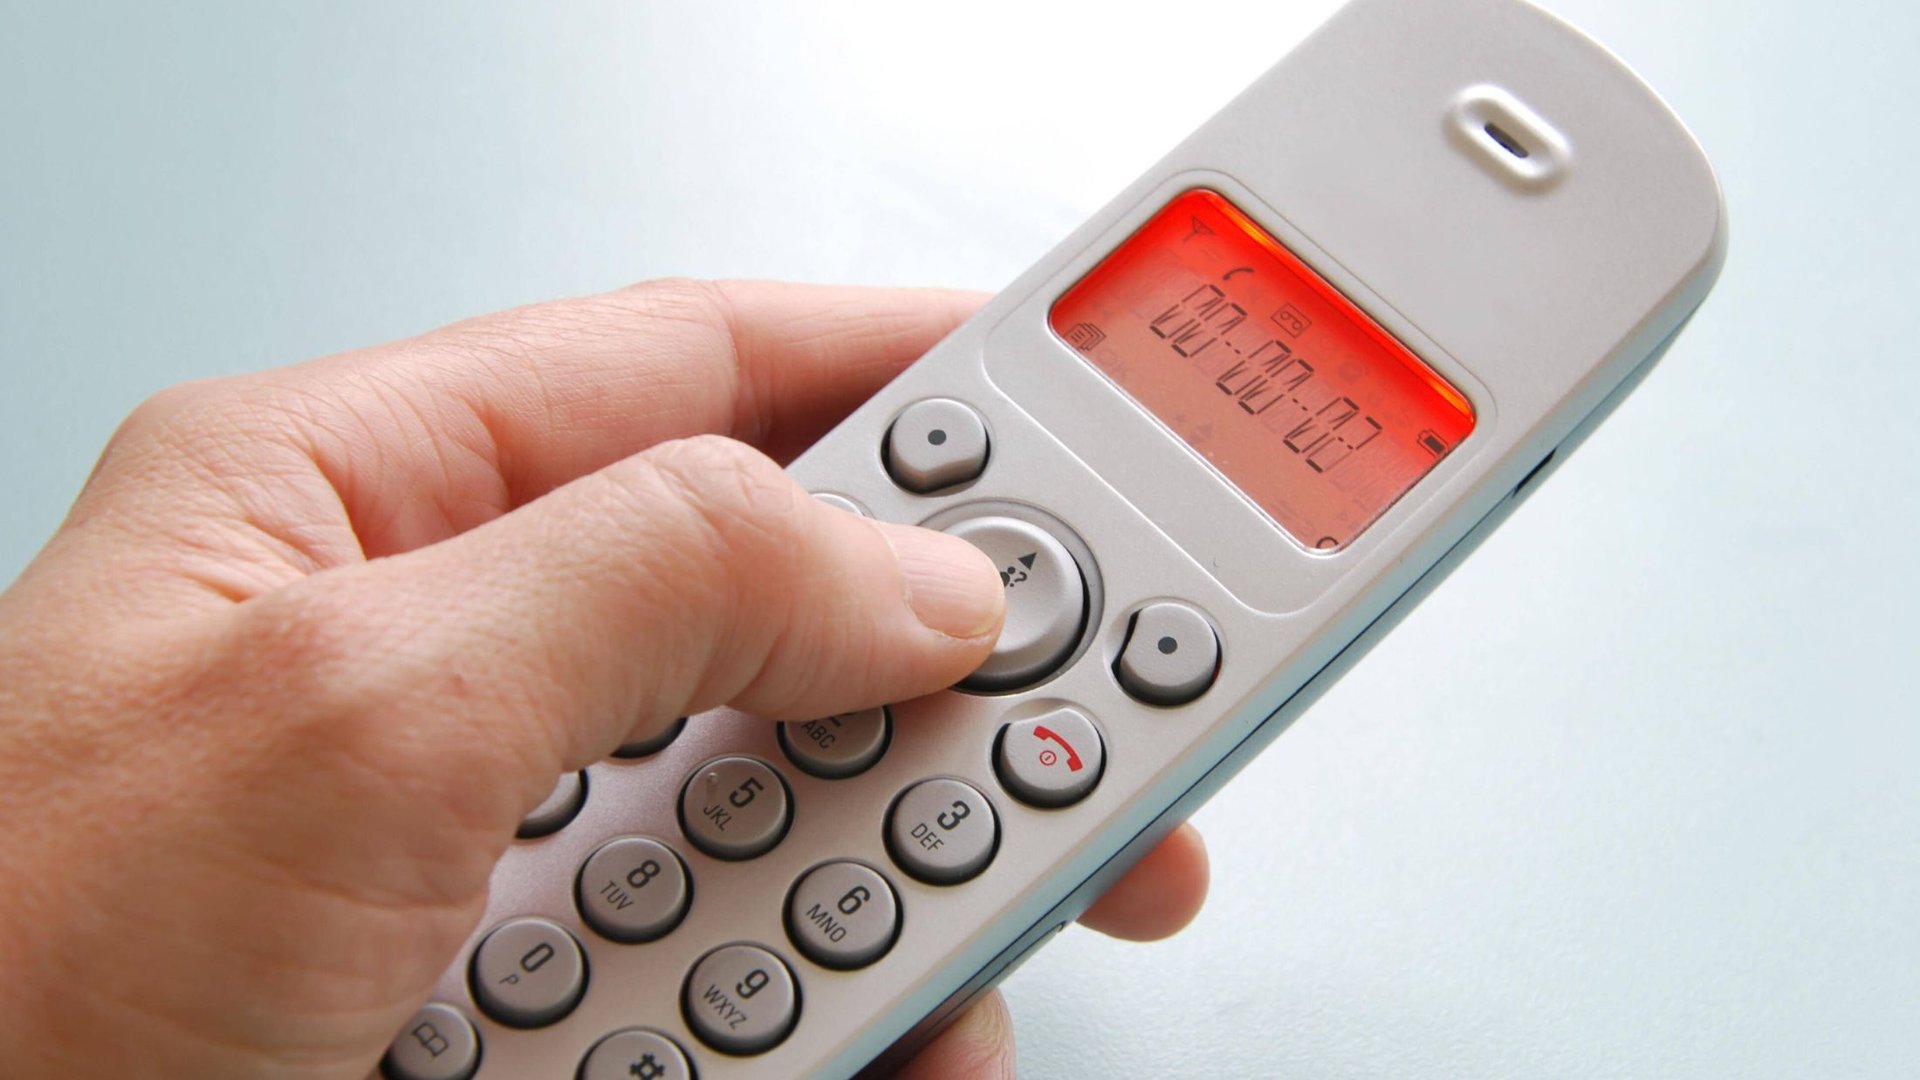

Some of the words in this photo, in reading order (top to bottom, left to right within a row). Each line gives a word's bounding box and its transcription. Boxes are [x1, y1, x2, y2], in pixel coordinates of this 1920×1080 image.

[802, 720, 836, 749] ABC
[729, 777, 764, 808] 5
[704, 805, 734, 832] JKL
[938, 800, 971, 831] 3
[910, 824, 944, 851] DEF
[627, 859, 660, 889] 8
[600, 881, 633, 911] TUV
[837, 886, 870, 915] 6
[807, 904, 846, 943] MNO
[520, 943, 554, 972] 0
[500, 974, 519, 986] P
[736, 969, 770, 999] 9
[703, 984, 747, 1031] WXYZ
